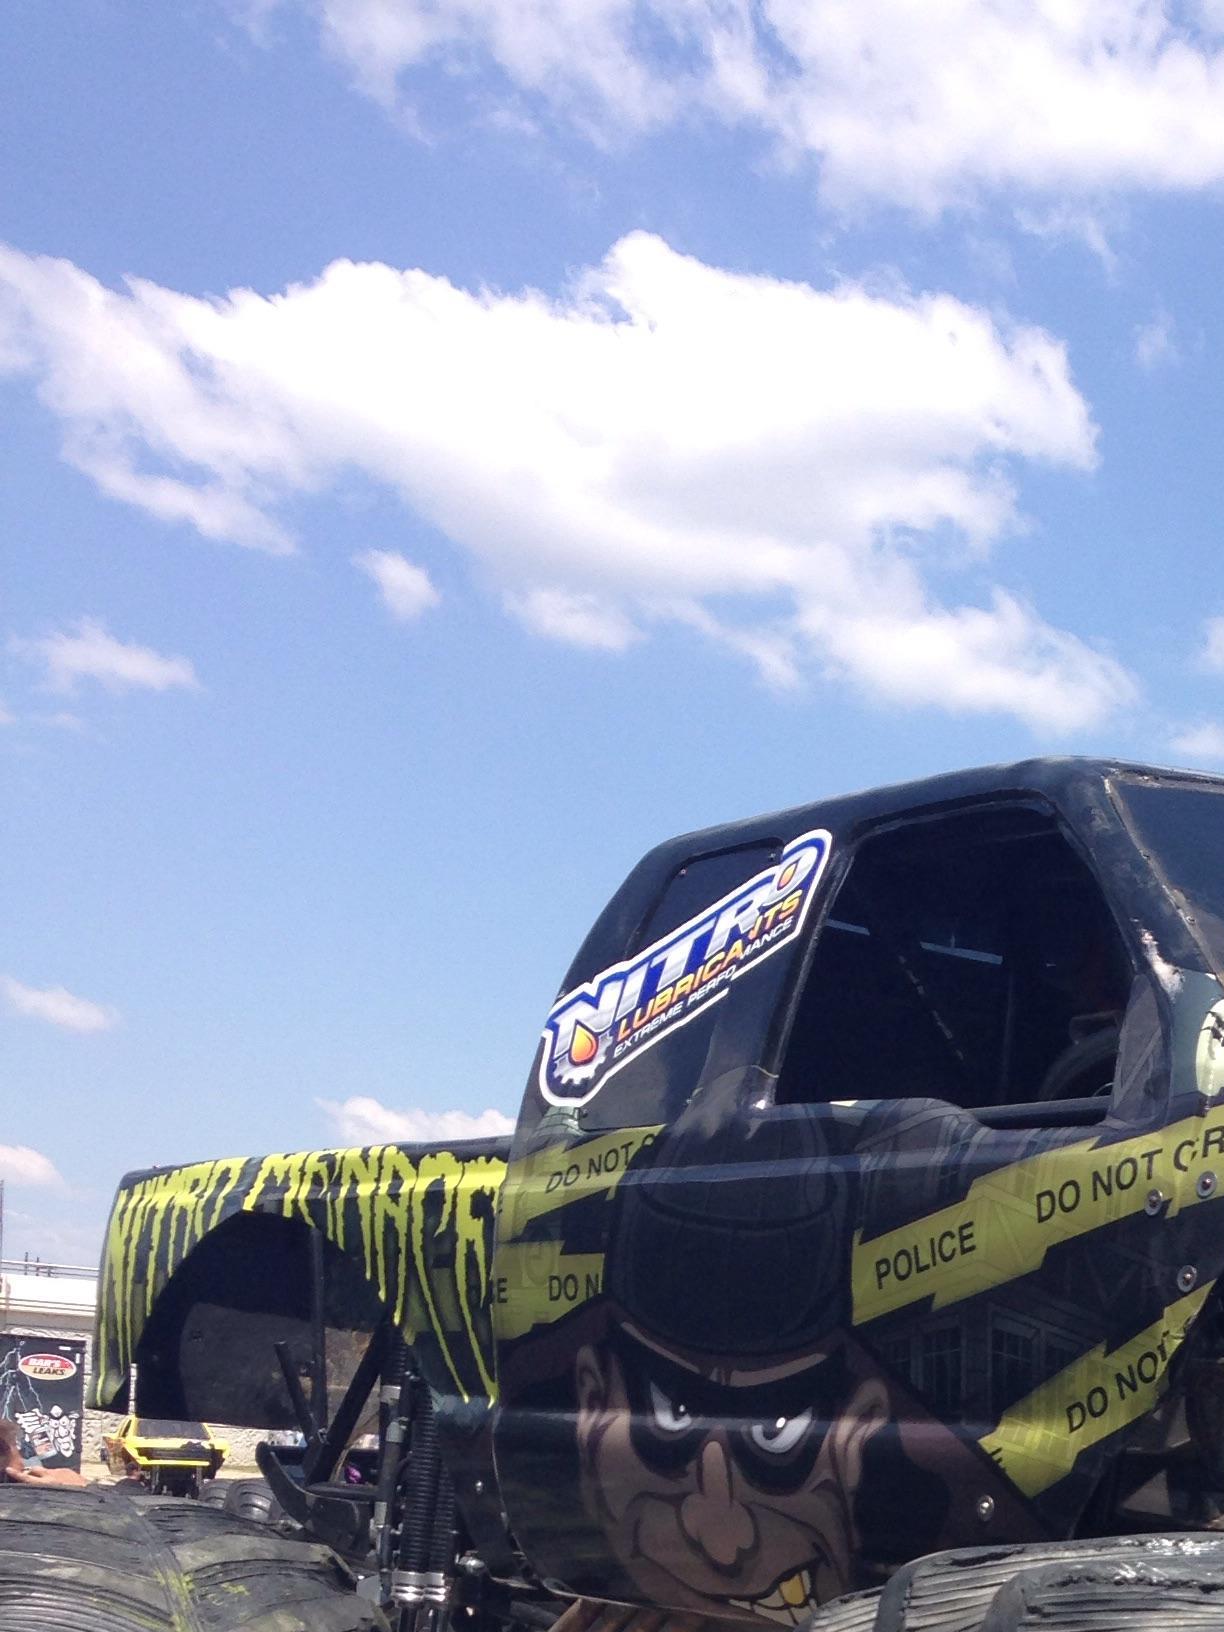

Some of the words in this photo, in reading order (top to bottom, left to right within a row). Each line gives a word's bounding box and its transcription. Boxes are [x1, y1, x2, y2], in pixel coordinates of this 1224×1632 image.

[552, 845, 818, 1058] NITRO
[613, 1001, 683, 1058] EXTREME
[545, 1165, 580, 1194] DO
[586, 1142, 634, 1180] NOT
[875, 1221, 976, 1290] POLICE
[1036, 1180, 1081, 1223] DO
[1092, 1148, 1163, 1201] NOT
[549, 1273, 578, 1301] DO
[33, 1367, 65, 1375] LEAKS
[1066, 1386, 1109, 1433] DO
